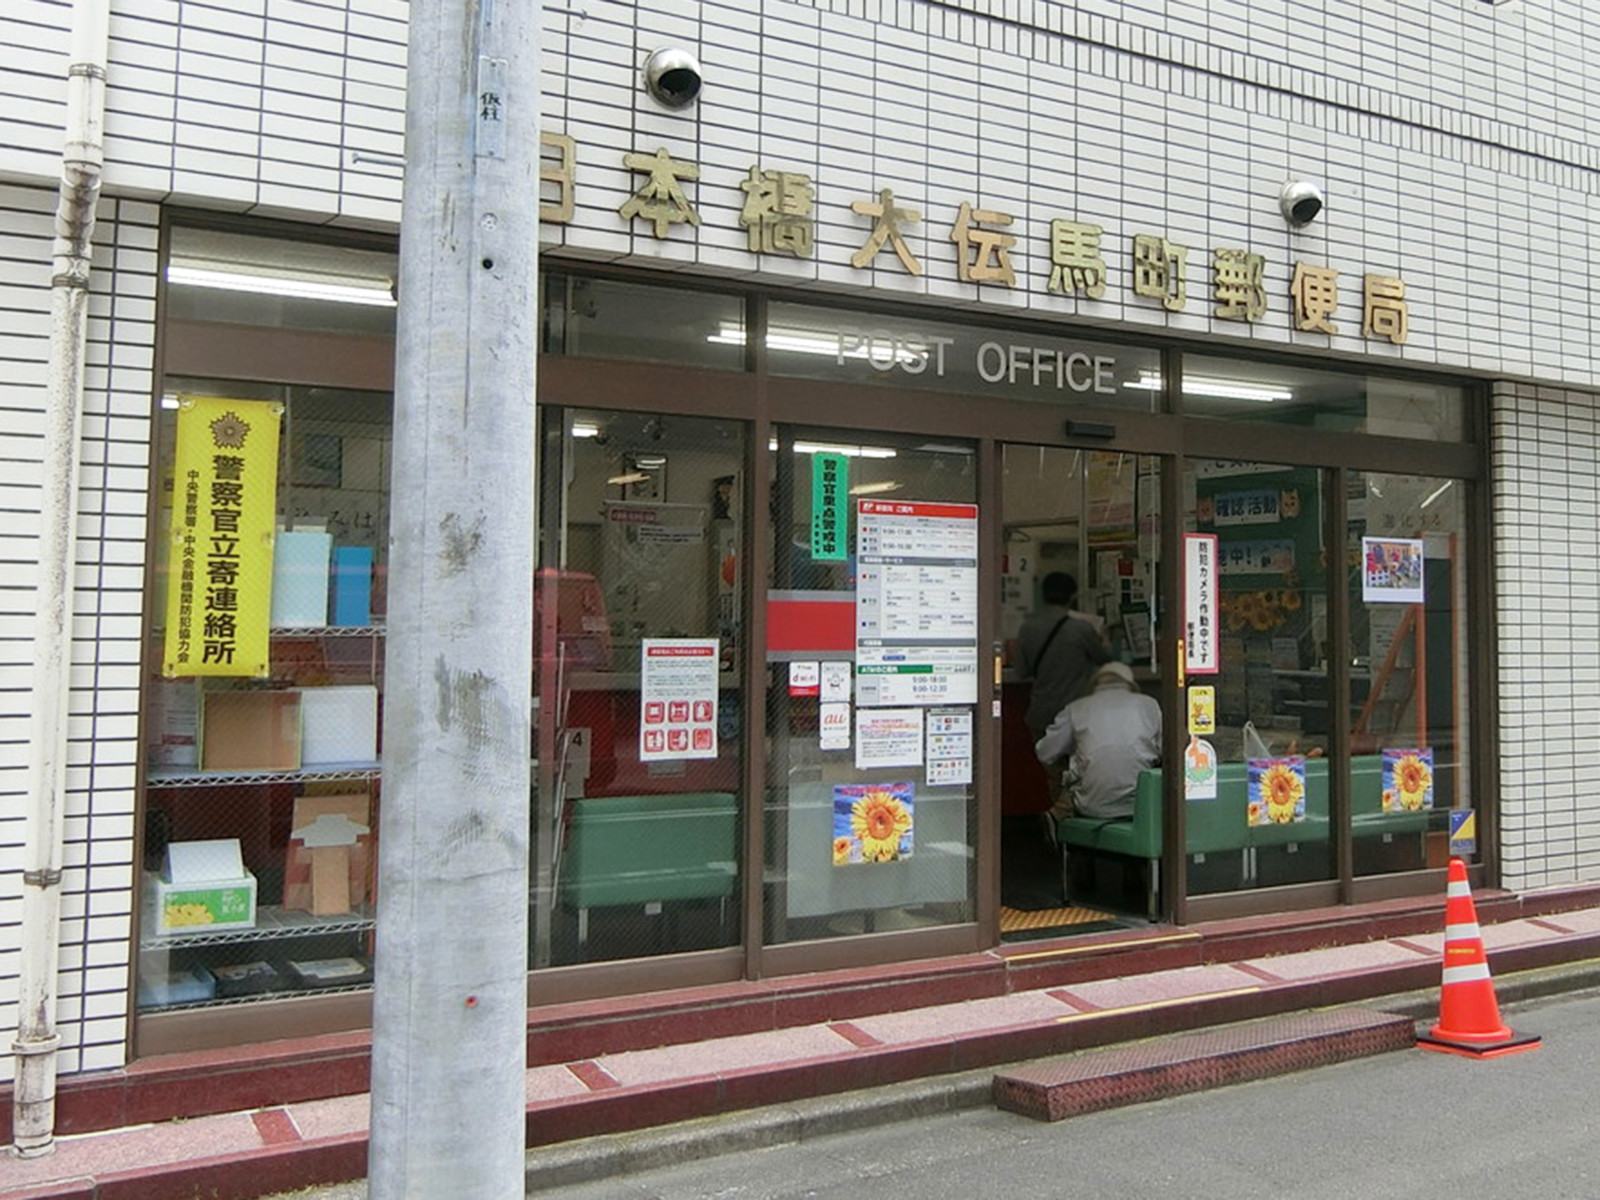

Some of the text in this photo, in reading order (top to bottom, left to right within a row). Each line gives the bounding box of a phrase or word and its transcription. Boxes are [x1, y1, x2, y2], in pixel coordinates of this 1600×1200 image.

[540, 131, 1408, 345] 日本橋大伝馬町郵便局
[836, 326, 1117, 395] POST OFFICE
[202, 454, 246, 665] 警察官立寄連絡所
[1019, 558, 1027, 572] 2
[572, 731, 582, 747] 4
[824, 714, 845, 725] au
